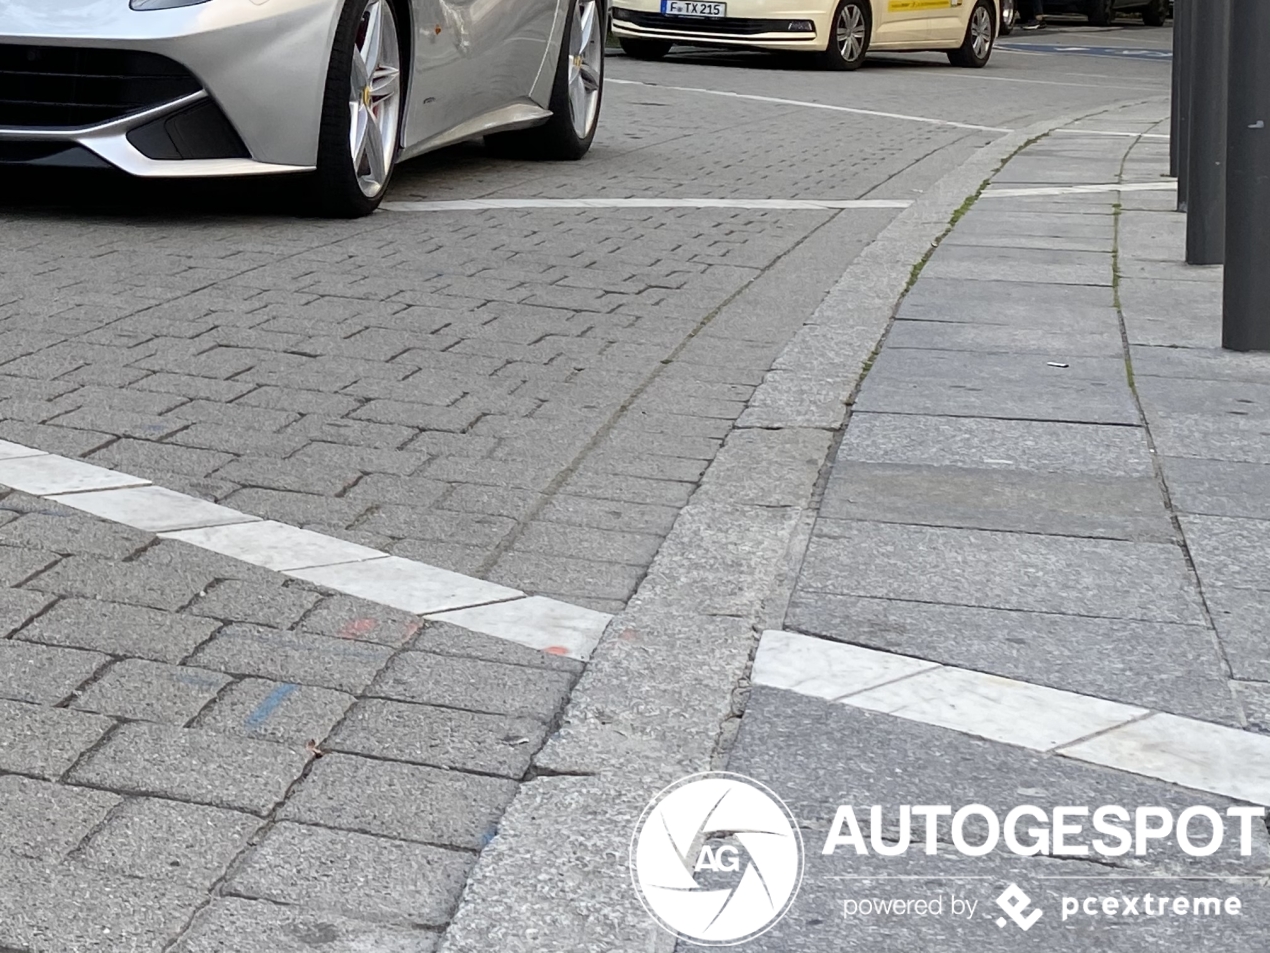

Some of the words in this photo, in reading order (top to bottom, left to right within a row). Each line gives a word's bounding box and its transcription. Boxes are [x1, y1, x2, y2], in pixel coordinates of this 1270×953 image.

[670, 1, 678, 12] F
[684, 2, 699, 14] TX
[699, 3, 721, 16] 215
